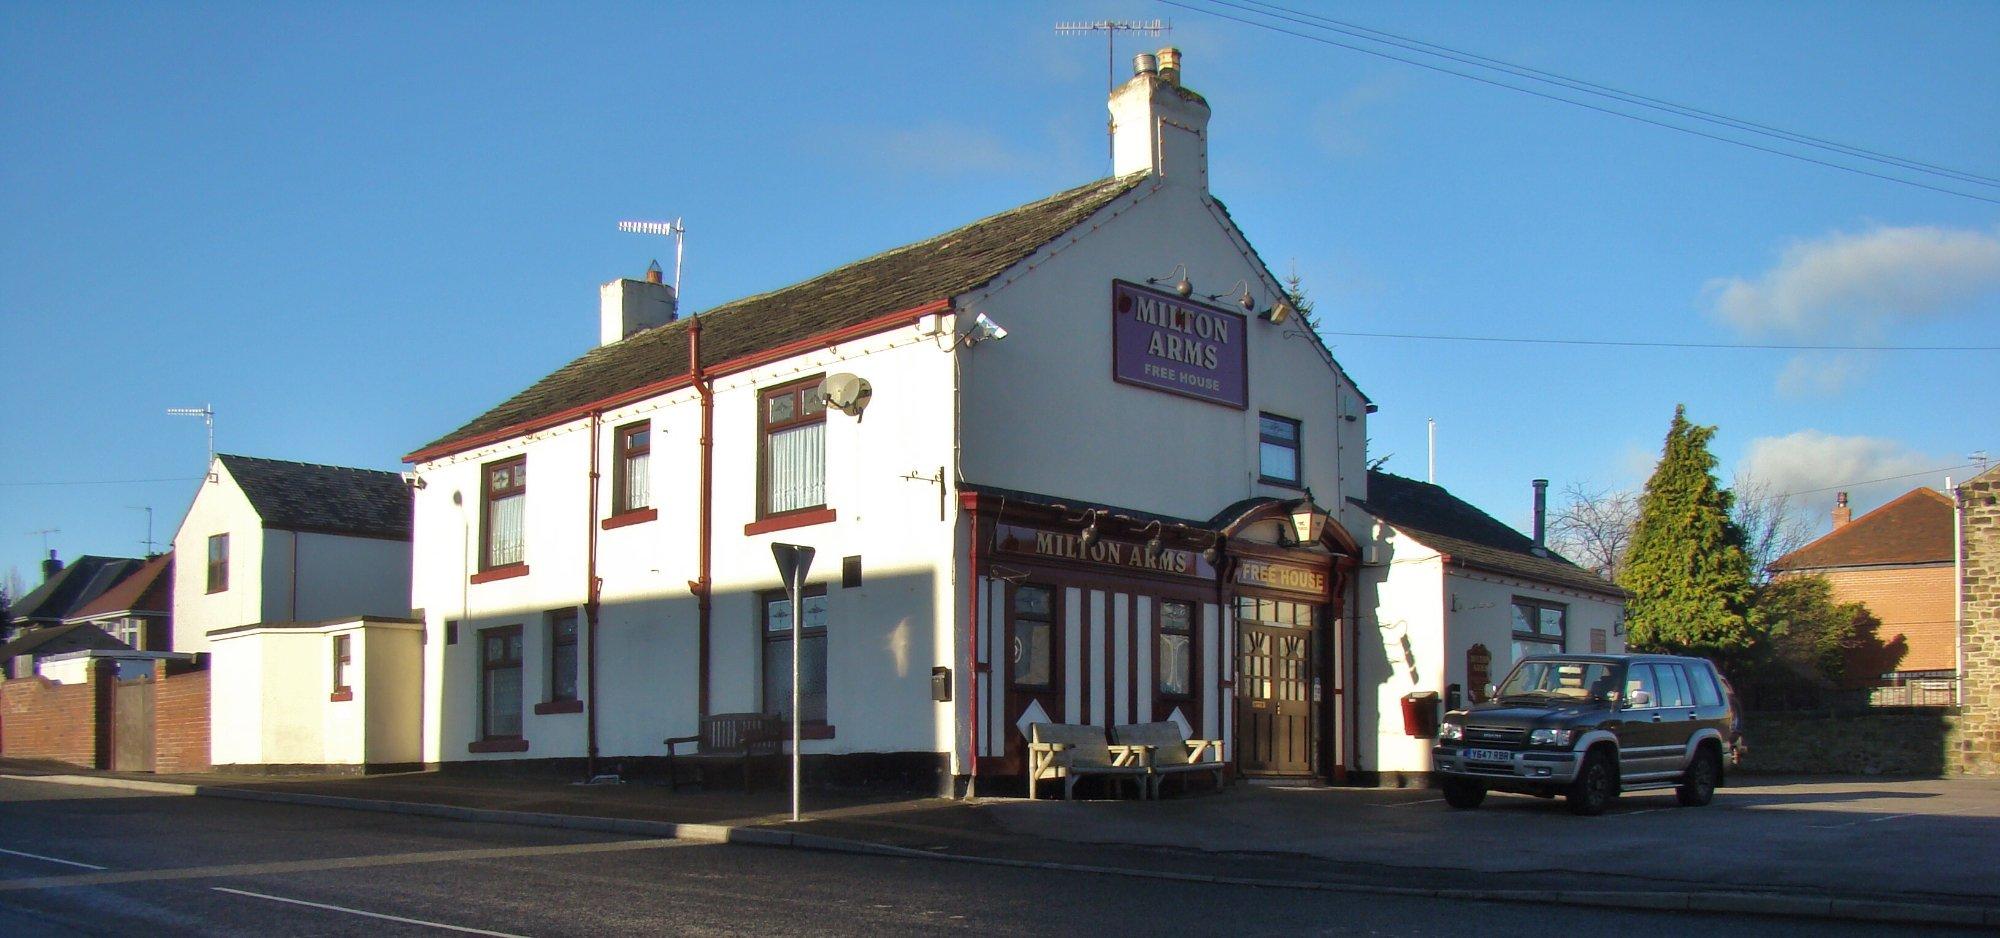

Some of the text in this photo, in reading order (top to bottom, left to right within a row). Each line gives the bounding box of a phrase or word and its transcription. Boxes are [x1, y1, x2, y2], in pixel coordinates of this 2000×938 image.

[1135, 296, 1228, 344] MILTON
[1148, 330, 1218, 370] ARMS
[1144, 364, 1220, 391] FREE HOUSE
[1035, 532, 1121, 565] MILTON
[1242, 562, 1324, 591] FREE HOUSE
